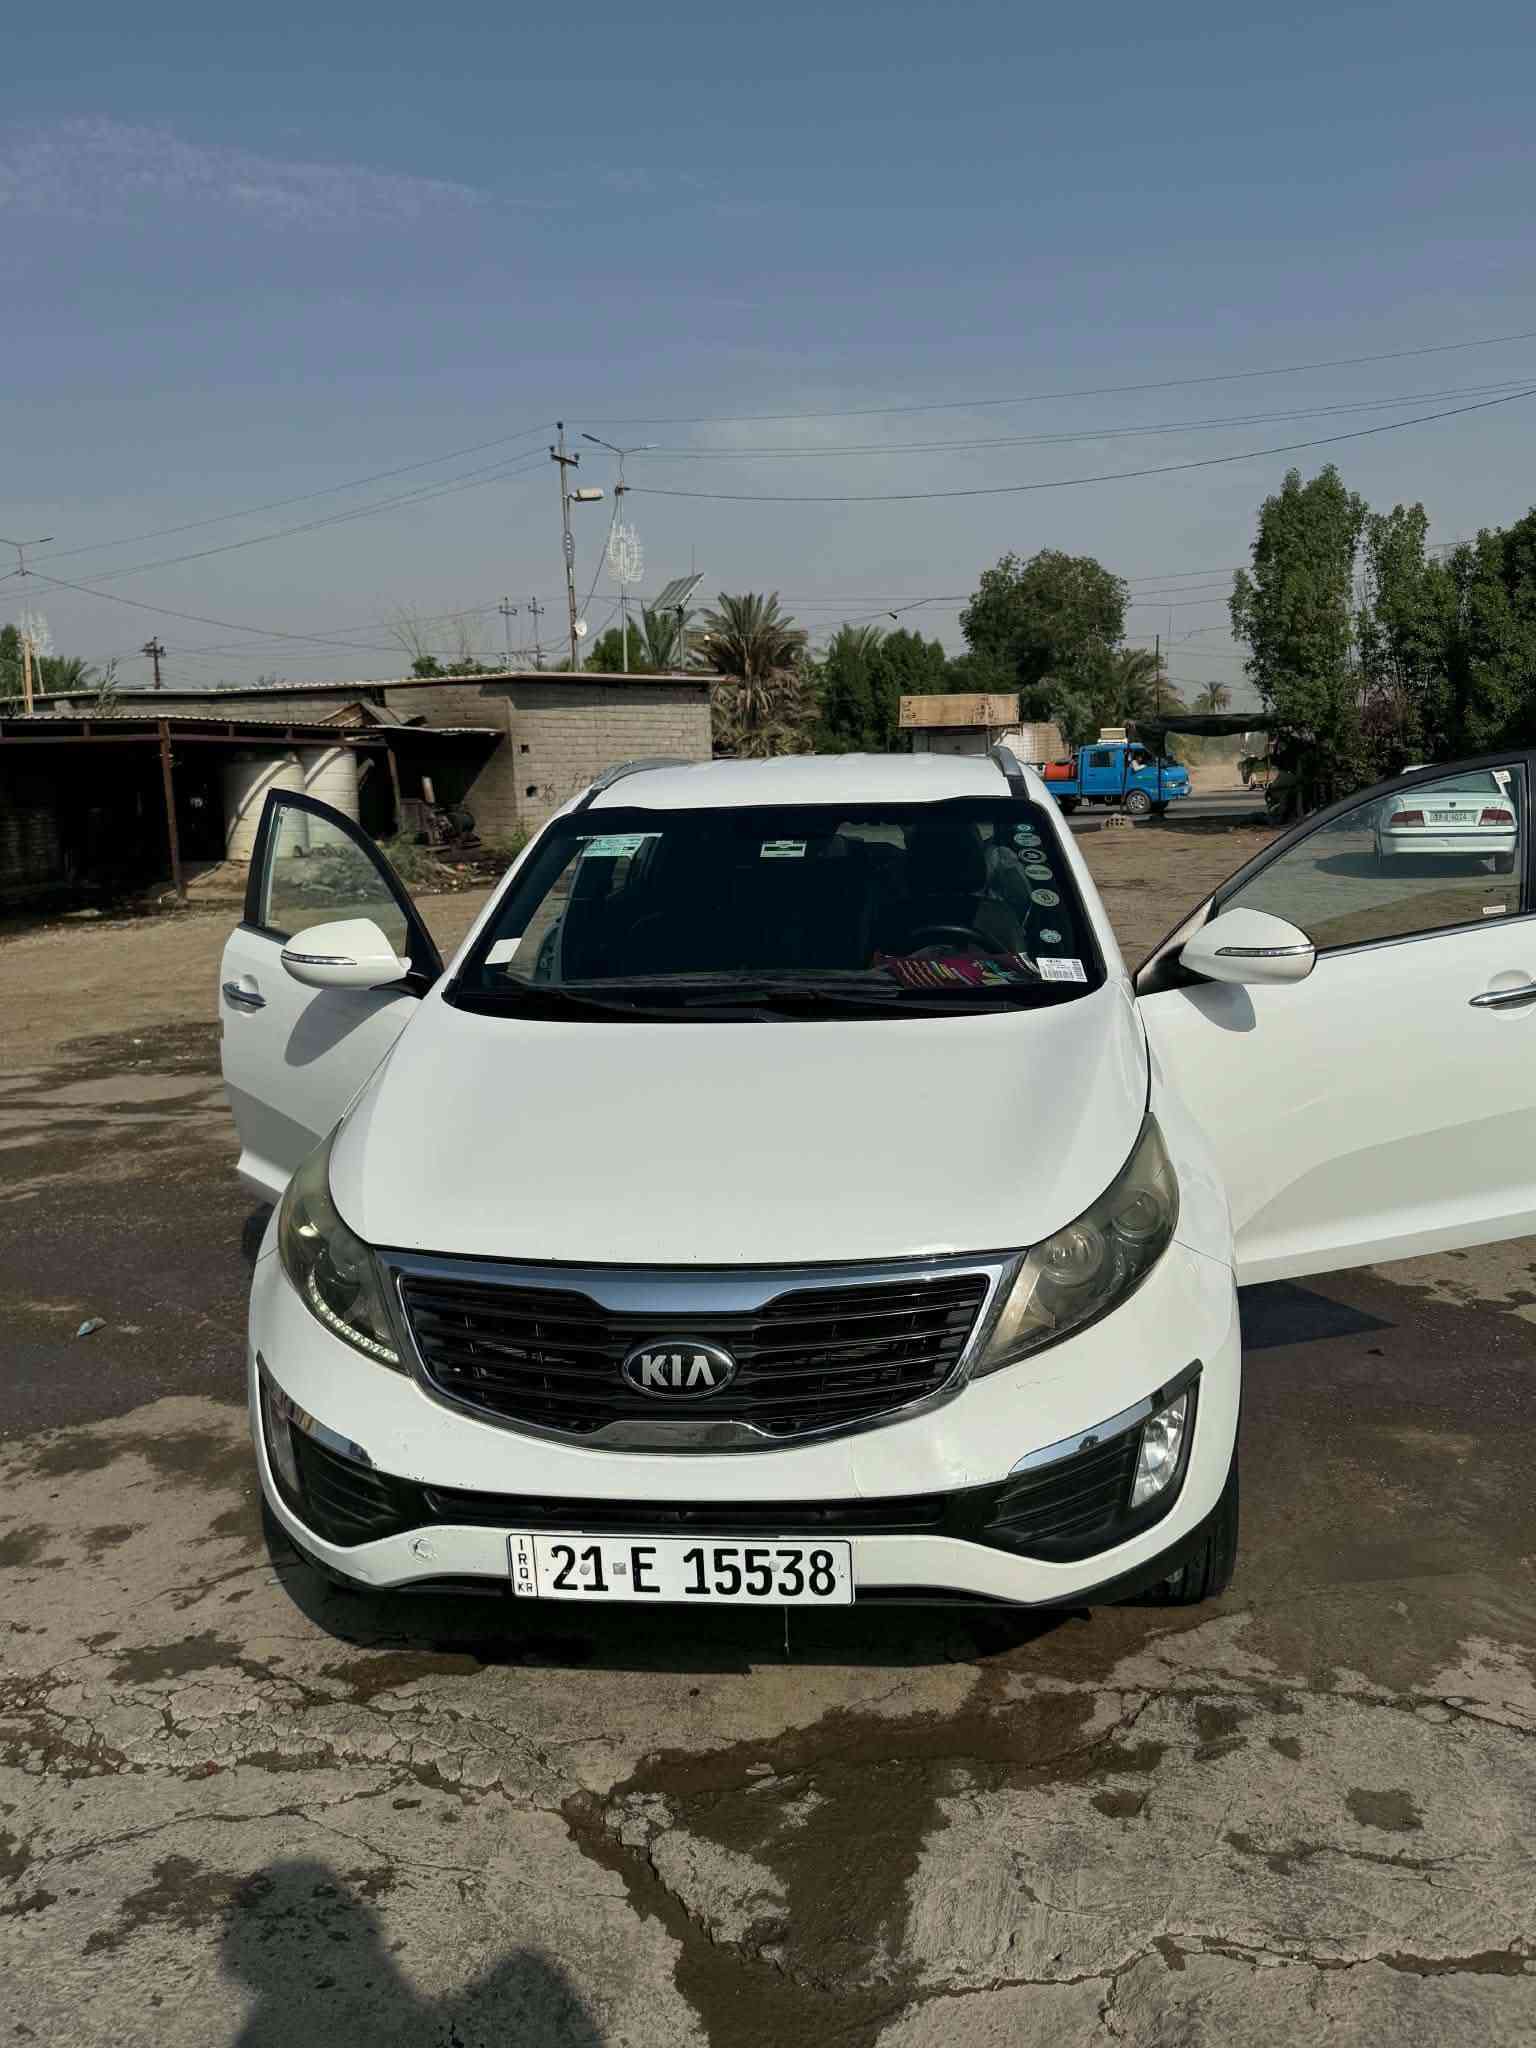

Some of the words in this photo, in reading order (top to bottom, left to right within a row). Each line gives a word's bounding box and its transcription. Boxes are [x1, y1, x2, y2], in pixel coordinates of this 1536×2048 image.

[641, 1354, 715, 1386] KIA
[551, 1544, 609, 1592] 21
[631, 1546, 661, 1593] E
[683, 1548, 836, 1596] 15538
